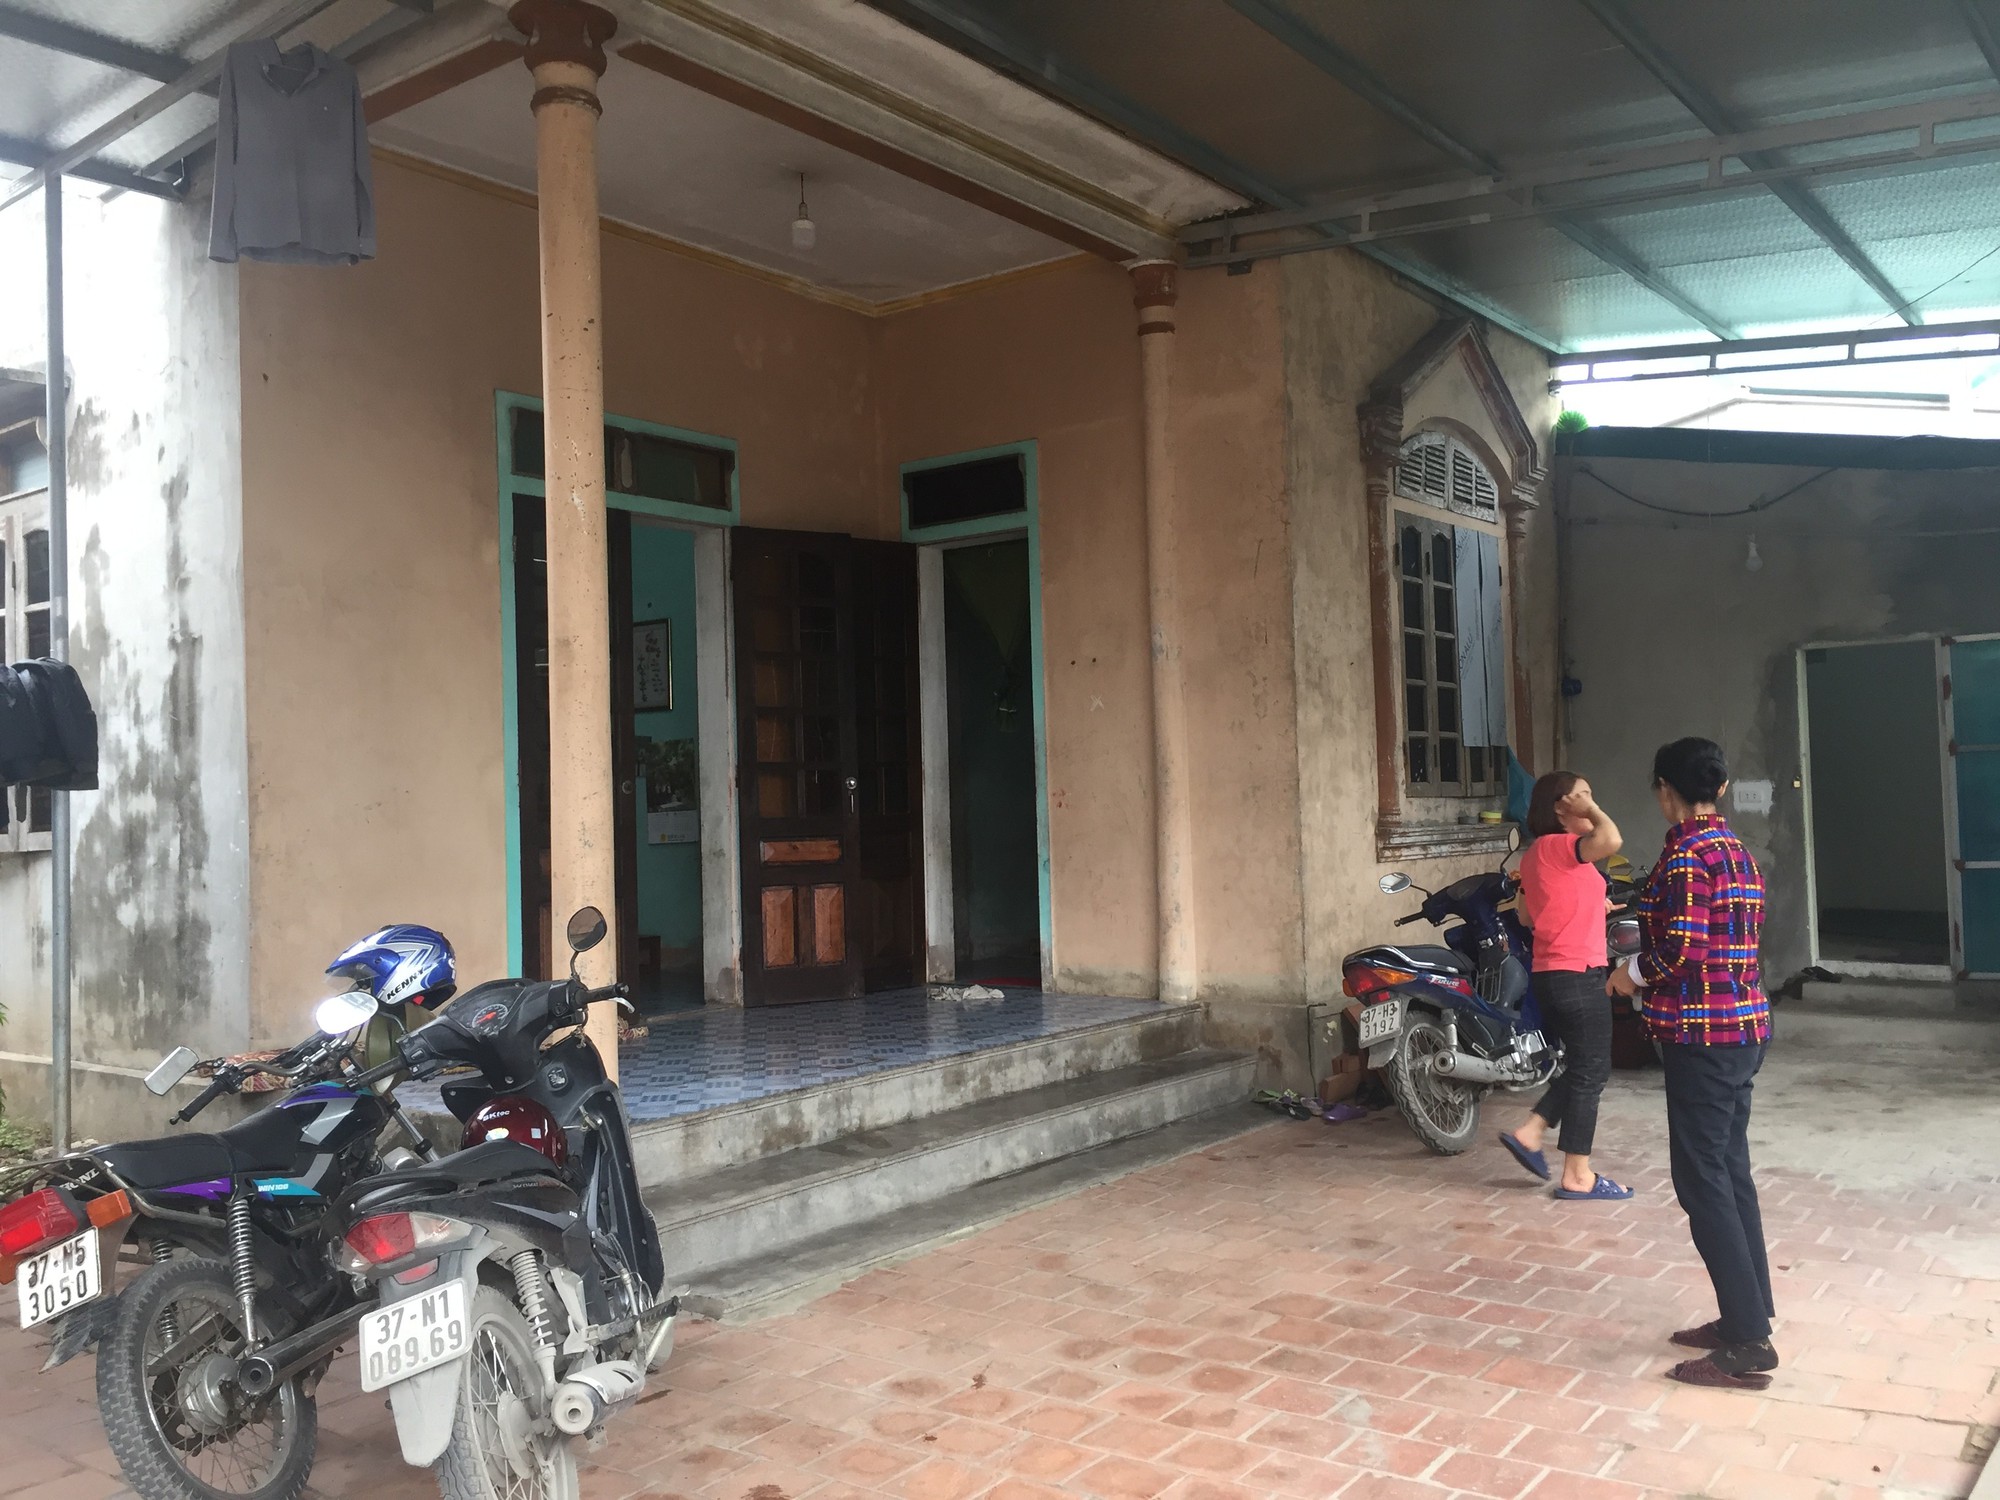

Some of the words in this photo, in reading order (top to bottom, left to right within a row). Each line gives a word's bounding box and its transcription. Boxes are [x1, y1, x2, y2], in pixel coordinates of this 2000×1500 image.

[387, 965, 431, 1001] KENNY
[1365, 1018, 1394, 1039] 3192
[27, 1236, 87, 1289] 37-N5
[28, 1269, 88, 1322] 3050
[376, 1289, 450, 1345] 37-N1
[369, 1319, 463, 1383] 089.69
